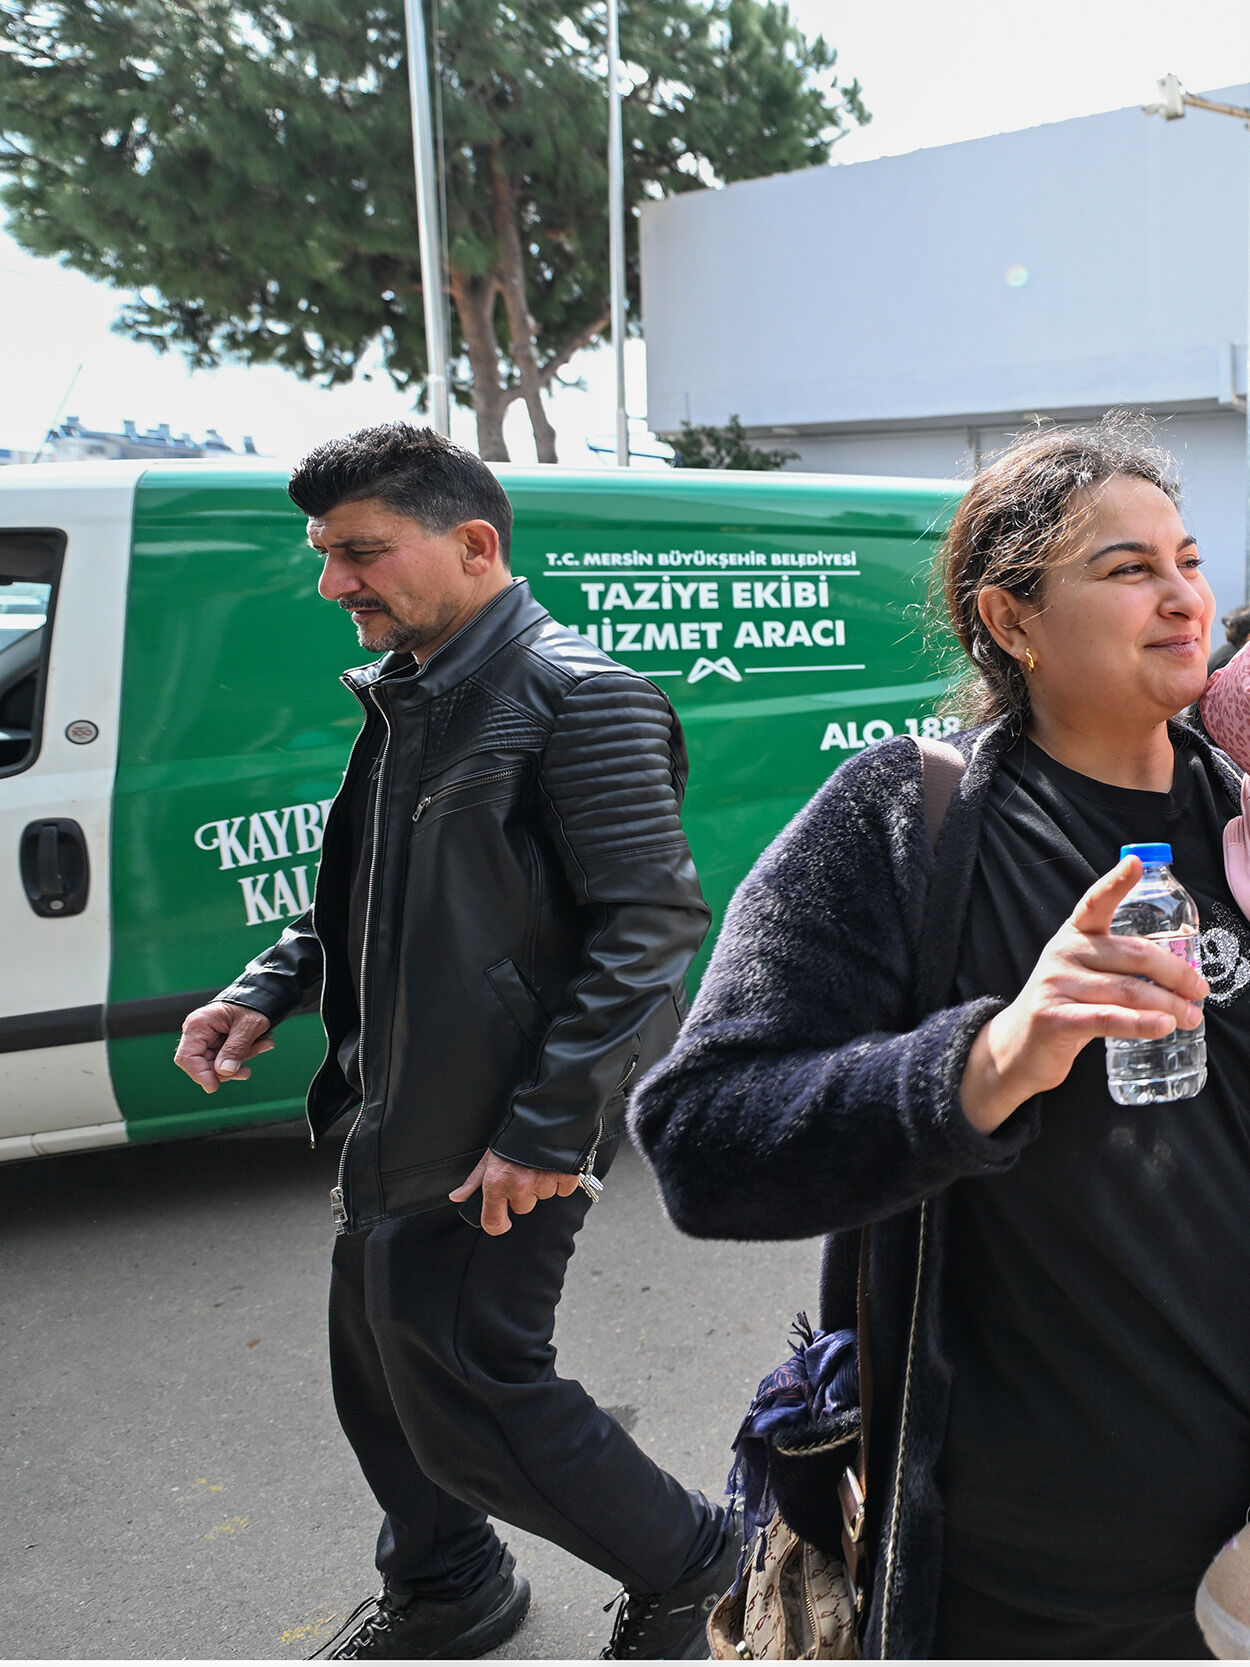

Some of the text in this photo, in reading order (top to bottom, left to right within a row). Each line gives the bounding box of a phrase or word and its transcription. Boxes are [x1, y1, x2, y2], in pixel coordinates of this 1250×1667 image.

[545, 549, 857, 569] T.C. MERSİN BÜYÜKŞEHİR BELEDİYESİ
[580, 575, 830, 611] TAZİYE EKİBİ
[567, 617, 846, 652] HİZMET ARACI
[820, 719, 895, 751] ALO
